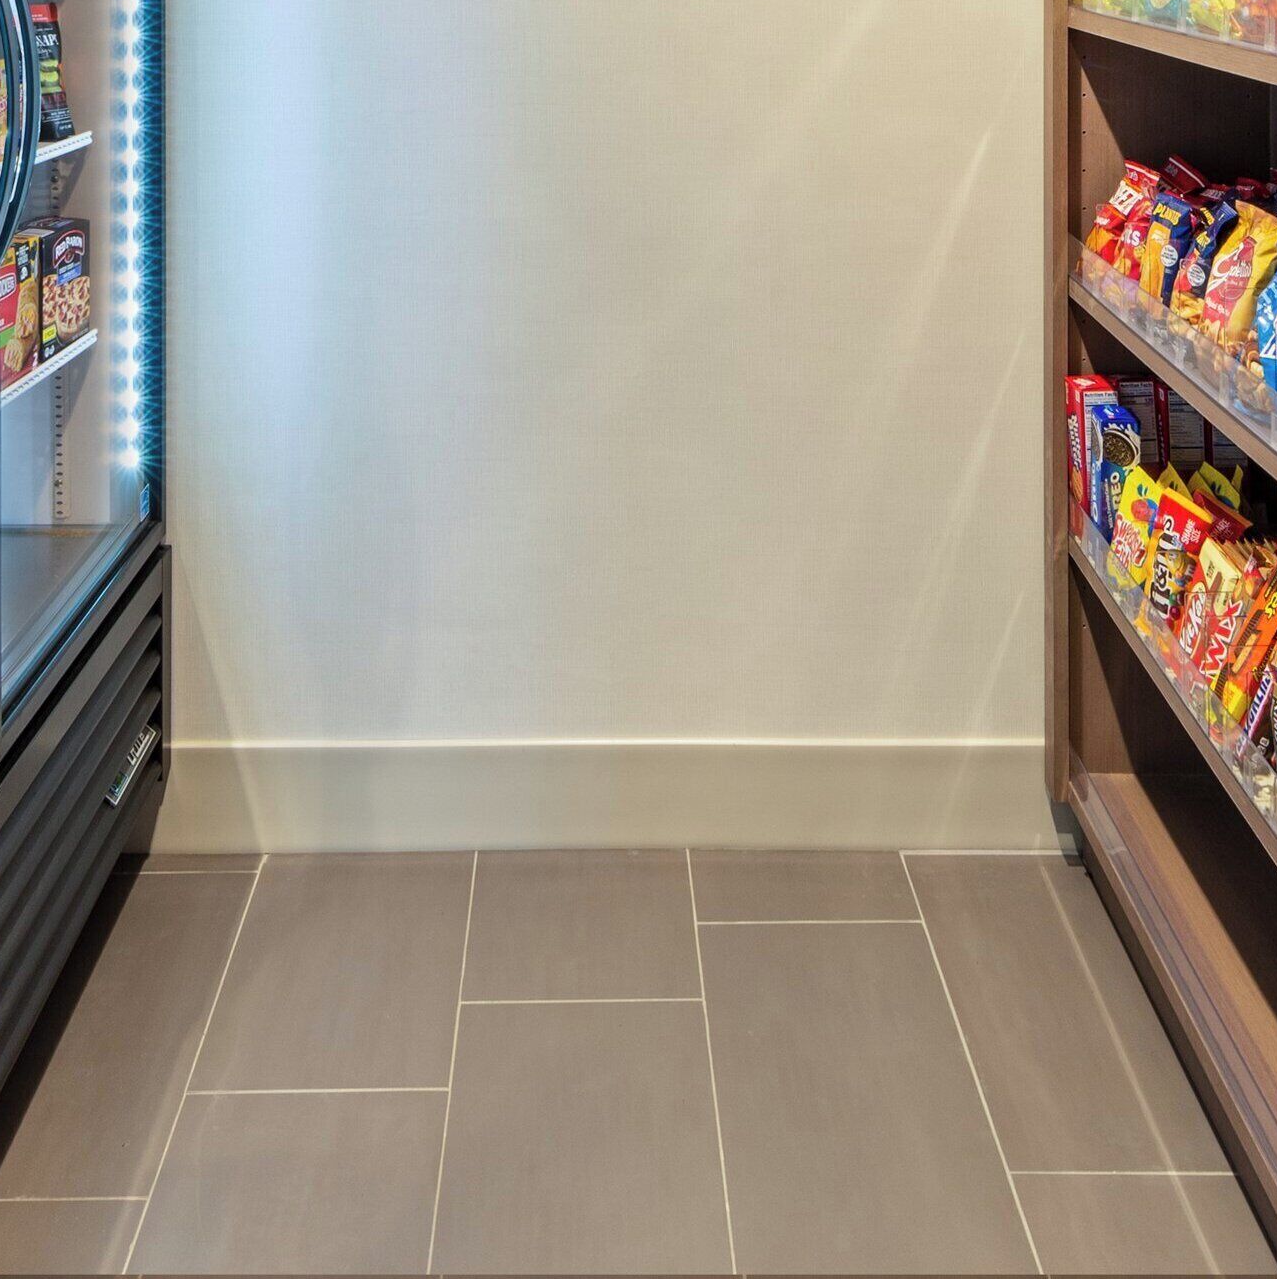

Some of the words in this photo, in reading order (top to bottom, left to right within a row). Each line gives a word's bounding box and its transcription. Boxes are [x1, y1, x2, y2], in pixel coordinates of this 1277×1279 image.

[1110, 470, 1122, 512] REO
[1180, 518, 1197, 546] SHARE
[1189, 529, 1202, 545] SIZE
